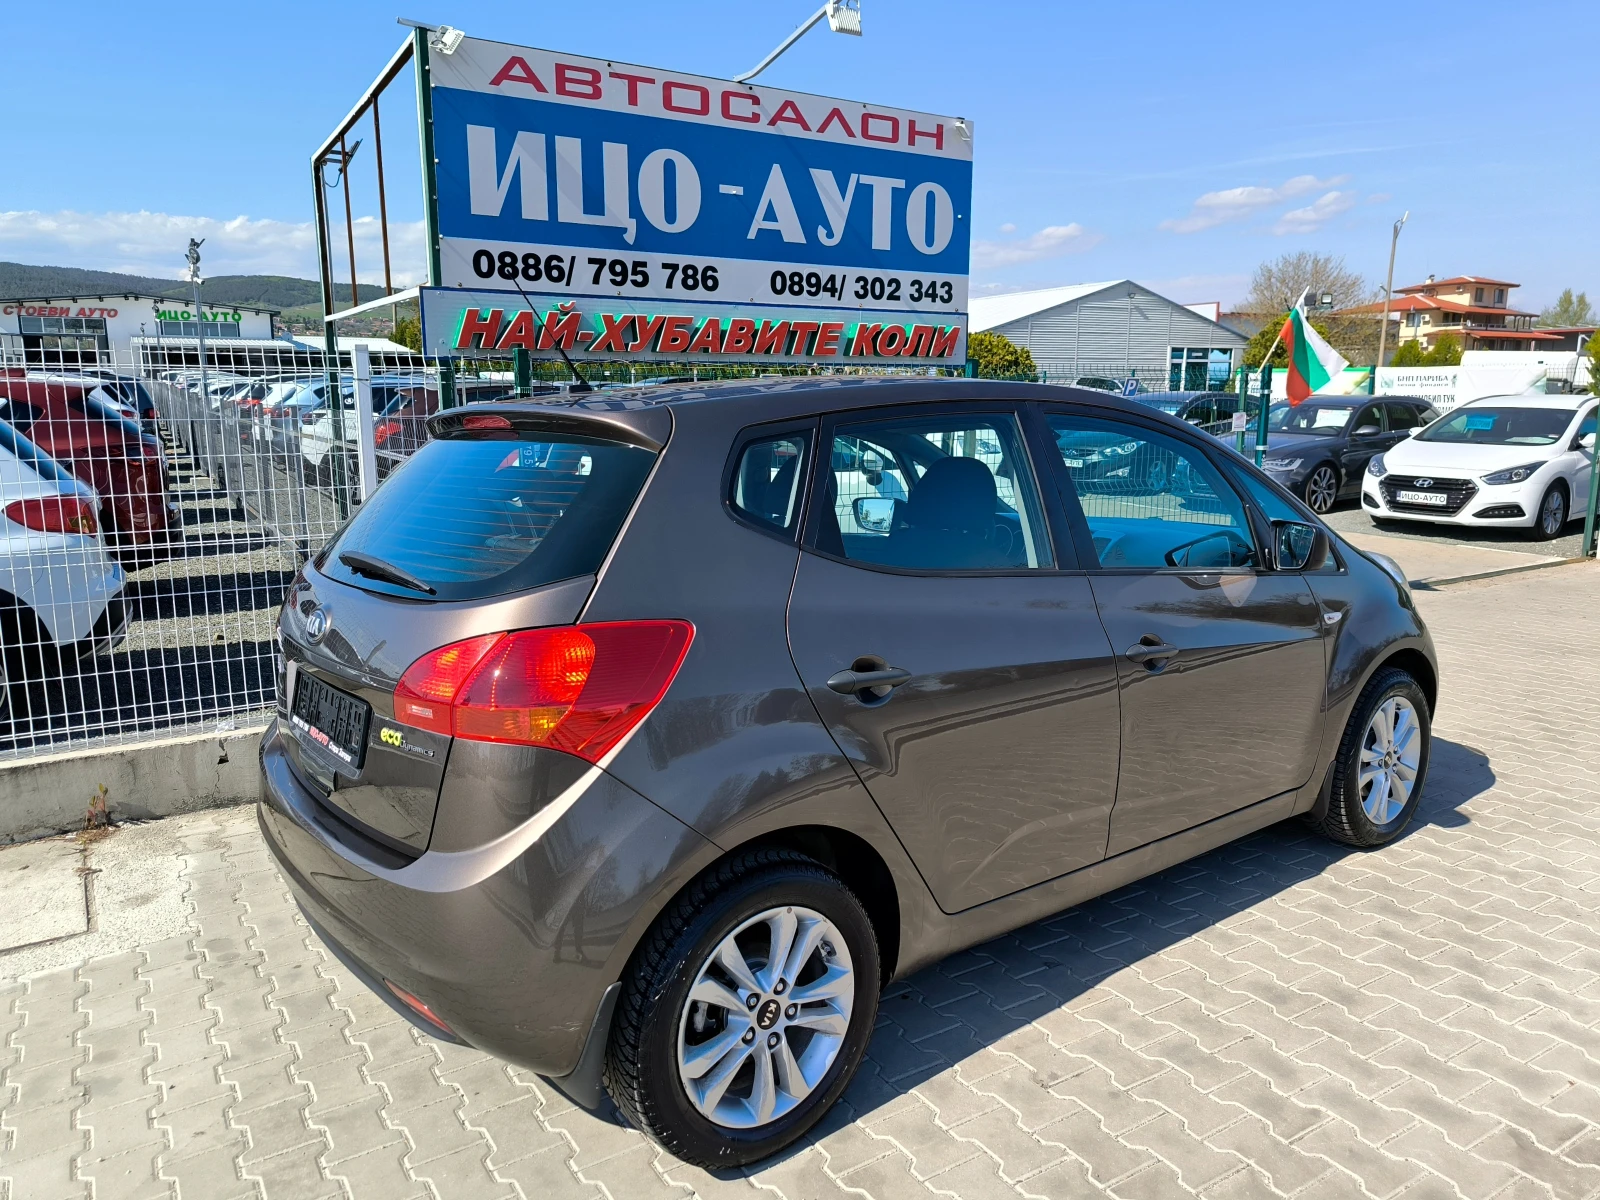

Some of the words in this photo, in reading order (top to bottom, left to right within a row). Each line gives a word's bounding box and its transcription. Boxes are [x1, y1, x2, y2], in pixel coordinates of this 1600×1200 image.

[489, 56, 944, 150] АВТОСАЛОН
[472, 249, 576, 287] 0886/
[588, 257, 650, 287] 795
[661, 262, 719, 292] 786
[770, 270, 846, 301] 0894/
[854, 276, 901, 301] 302
[909, 280, 953, 303] 343
[3, 305, 70, 317] СТОЕВИ
[77, 307, 118, 319] АУТО
[849, 323, 961, 357] КОЛИ
[1125, 379, 1137, 395] P
[1402, 493, 1447, 504] ИЦО-АУТО
[761, 1002, 777, 1026] KIA
